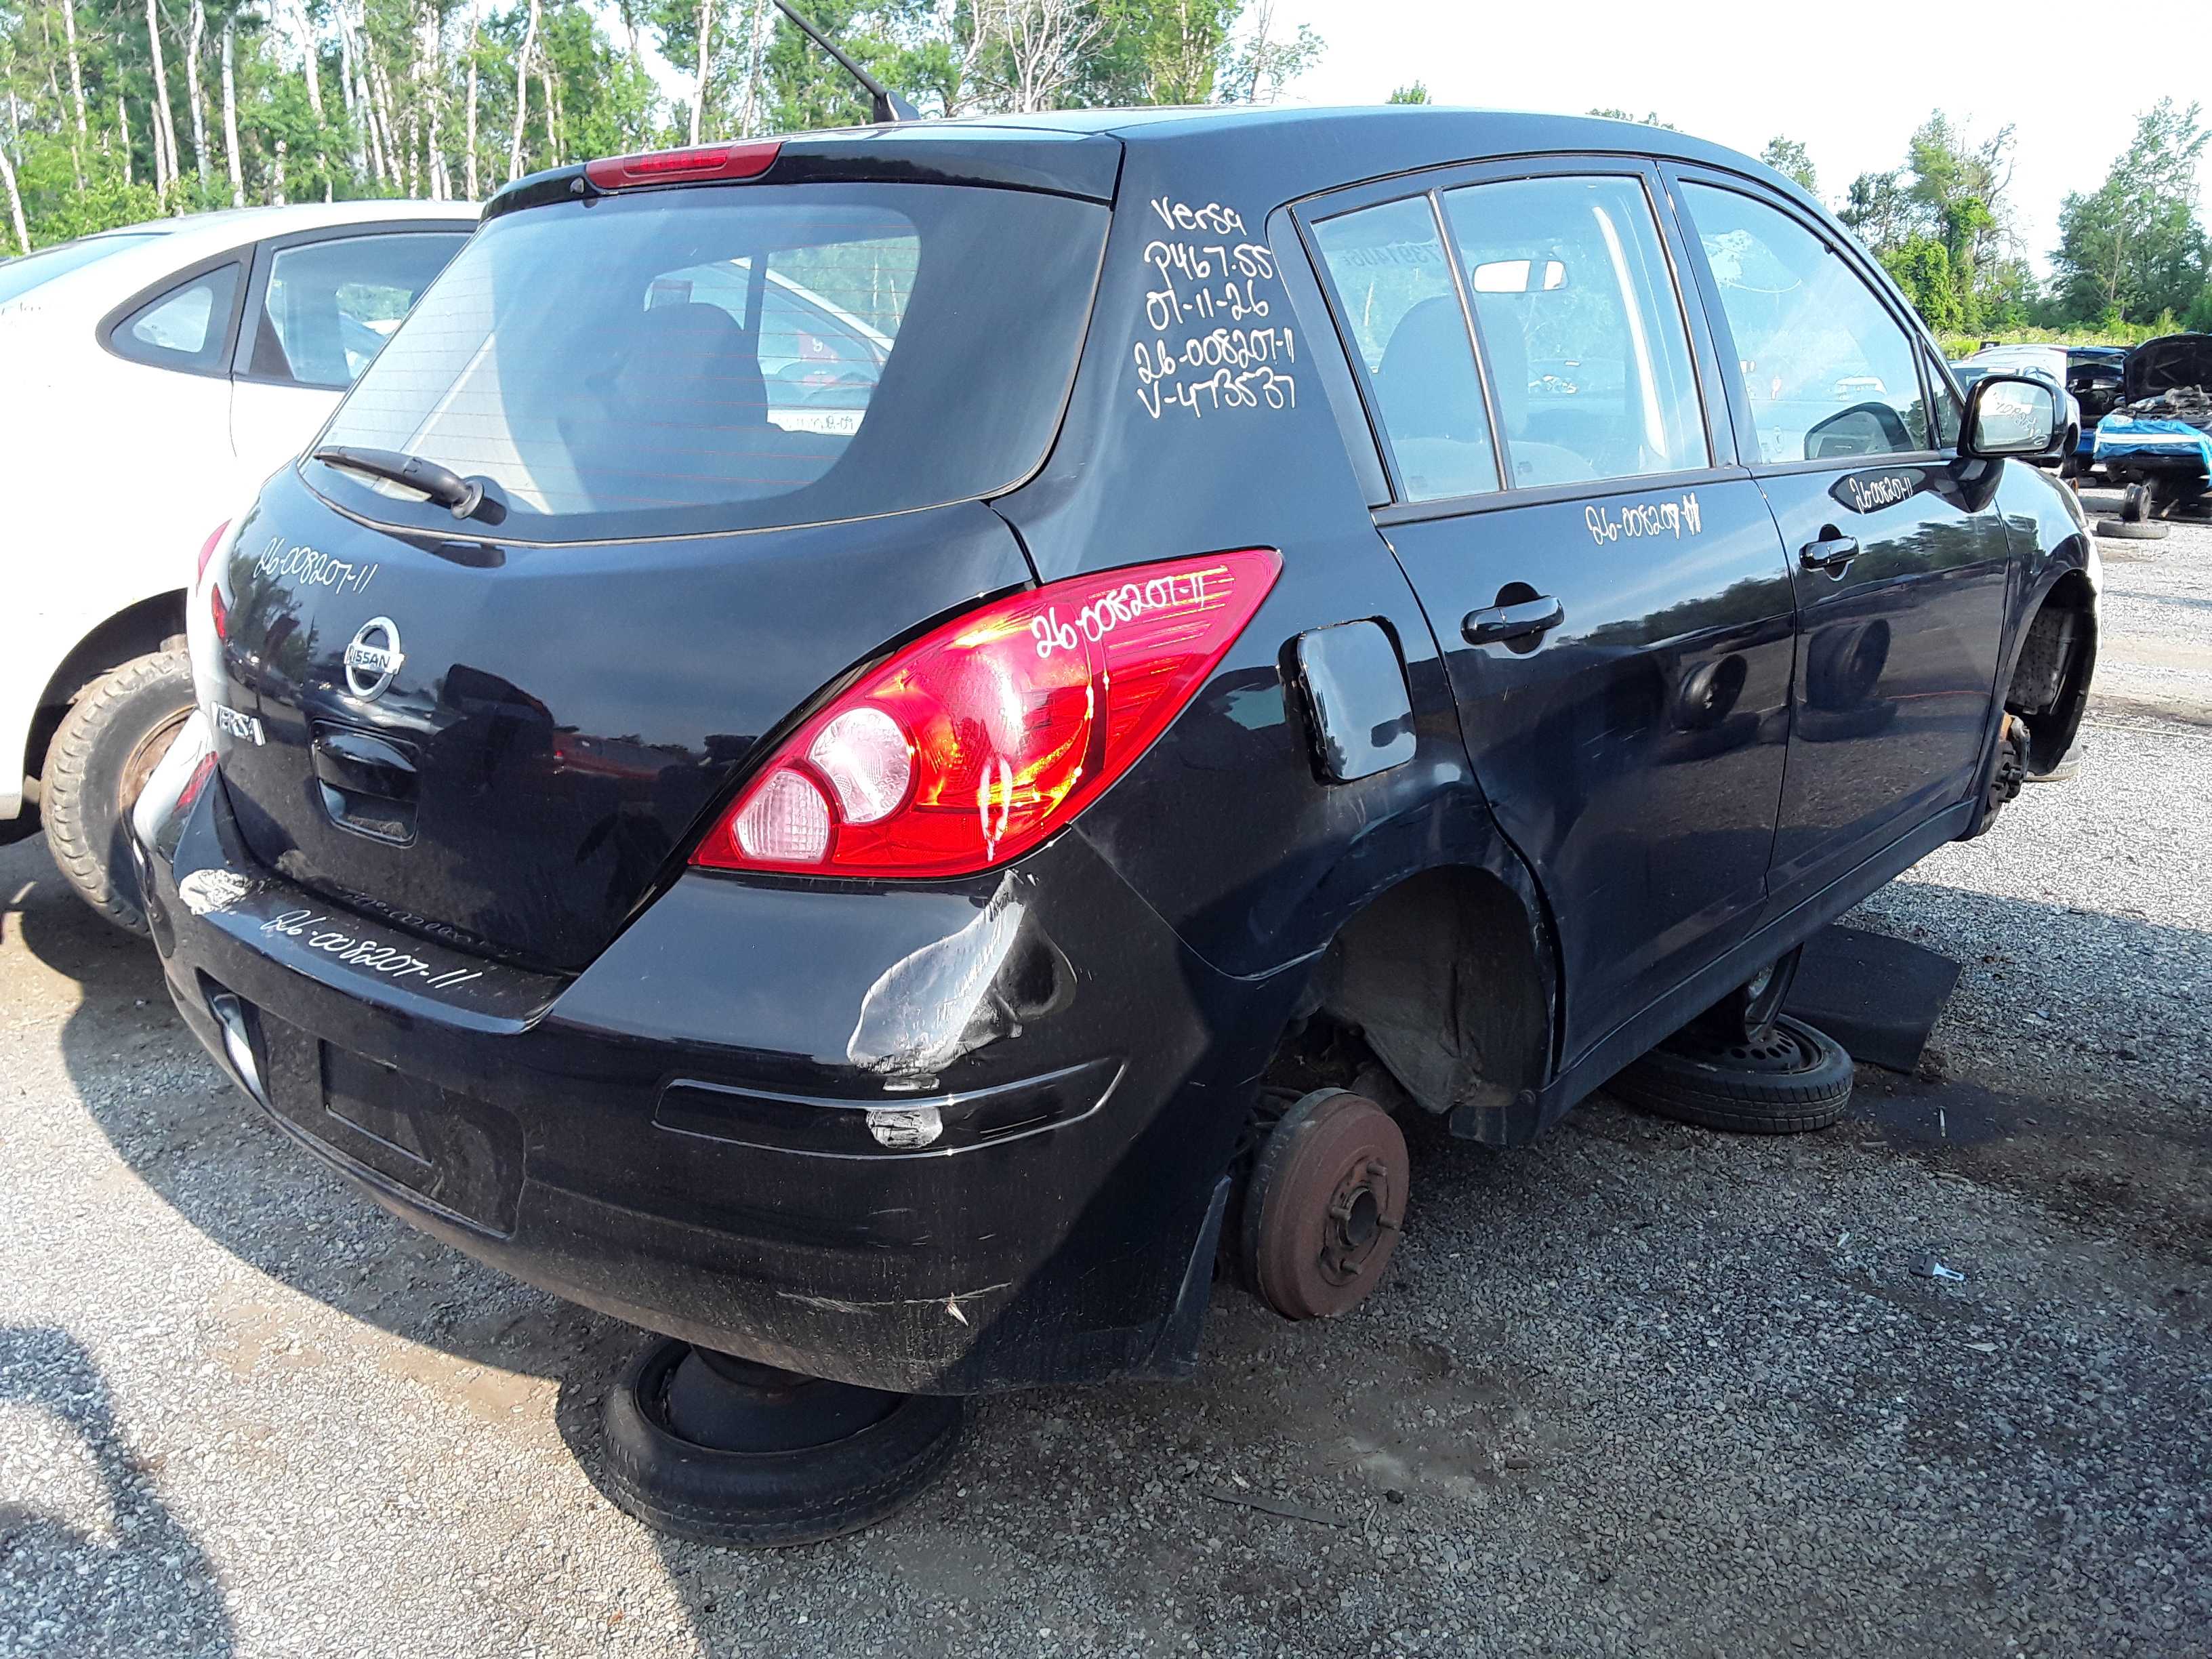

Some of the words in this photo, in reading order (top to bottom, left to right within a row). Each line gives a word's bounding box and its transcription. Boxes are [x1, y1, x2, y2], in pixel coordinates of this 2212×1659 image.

[1151, 197, 1247, 236] Versa
[1134, 328, 1295, 384] 26-008207-11
[1137, 366, 1295, 419] V-473537
[253, 537, 378, 594] 26-008207-11
[346, 645, 391, 668] NISSAN
